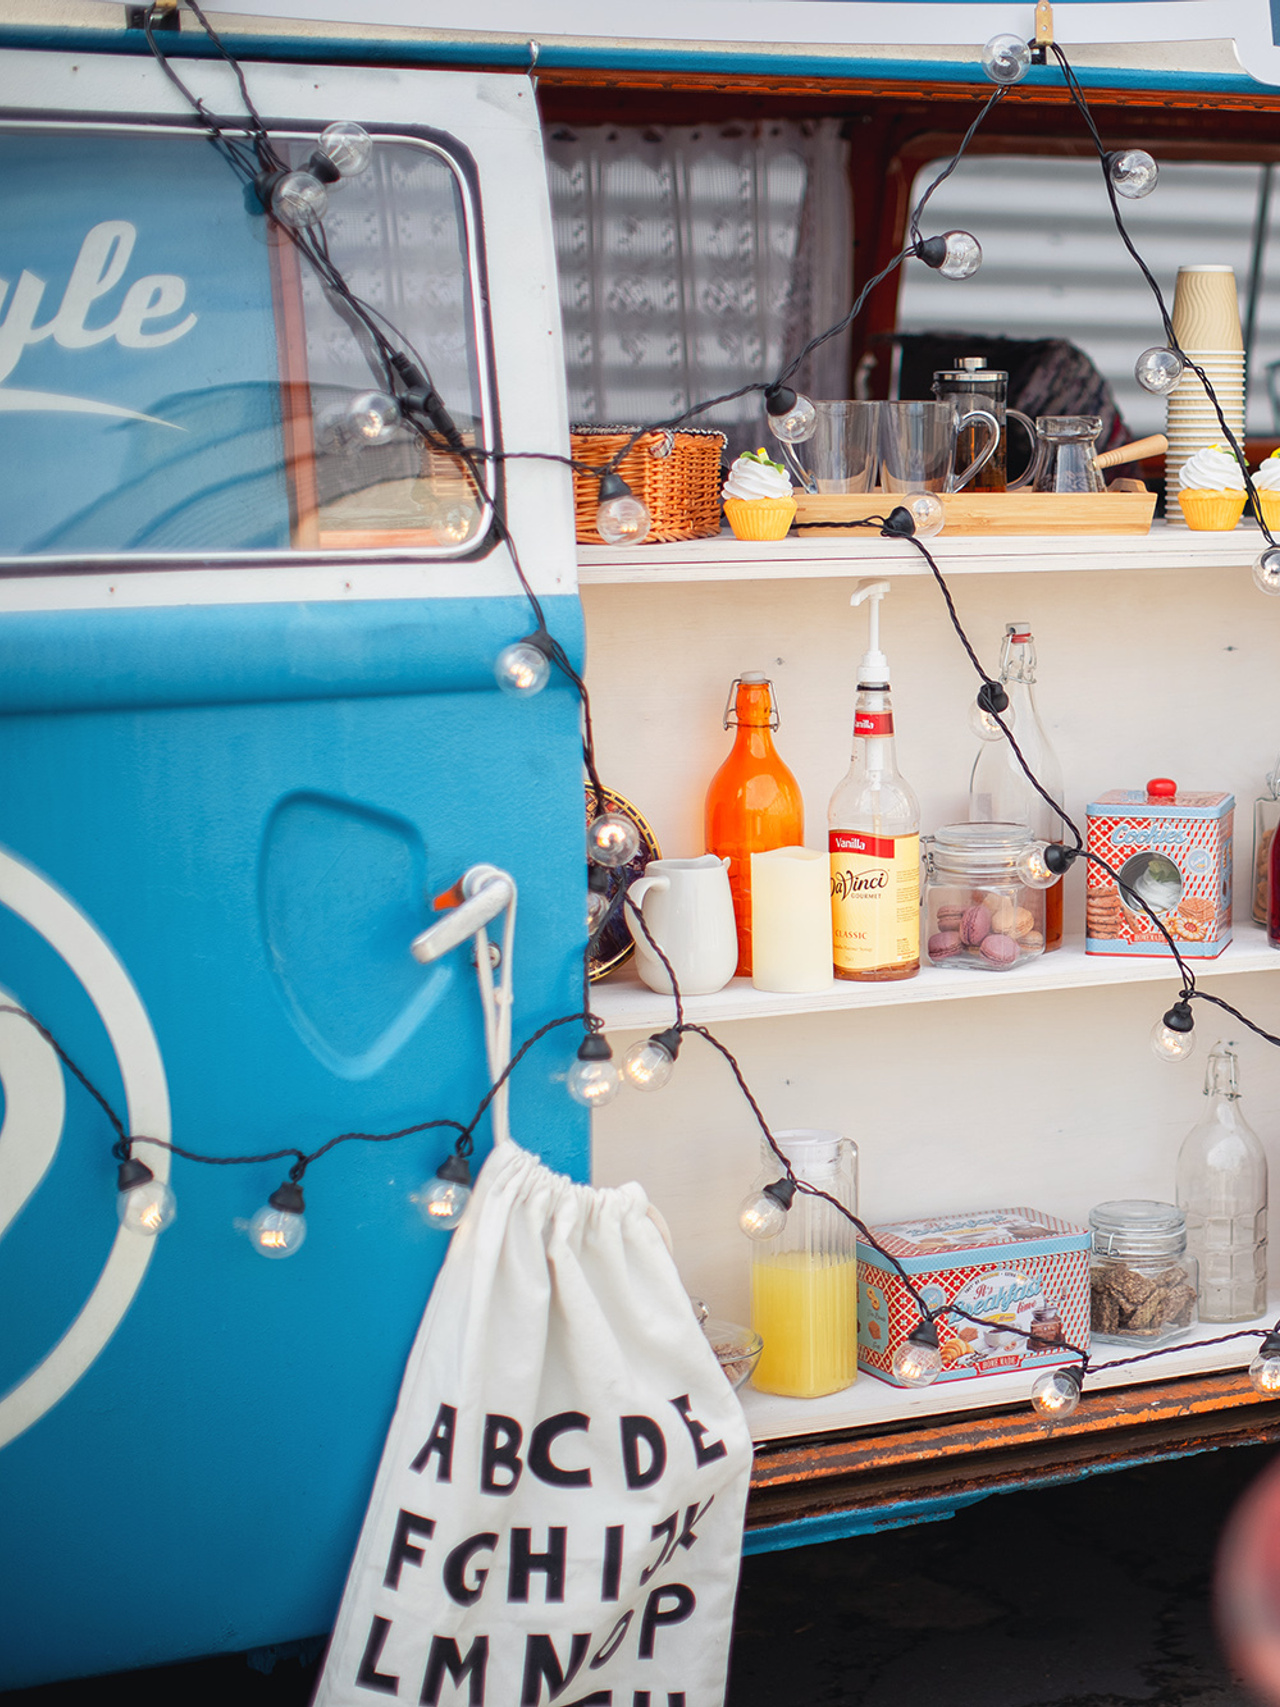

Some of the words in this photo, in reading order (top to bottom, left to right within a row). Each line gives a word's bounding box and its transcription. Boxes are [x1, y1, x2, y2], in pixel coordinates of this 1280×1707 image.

[1110, 823, 1189, 845] Cookies
[835, 837, 866, 851] Vanilla
[835, 928, 868, 940] CLASSIC
[973, 1282, 994, 1300] It's
[1016, 1299, 1037, 1314] time
